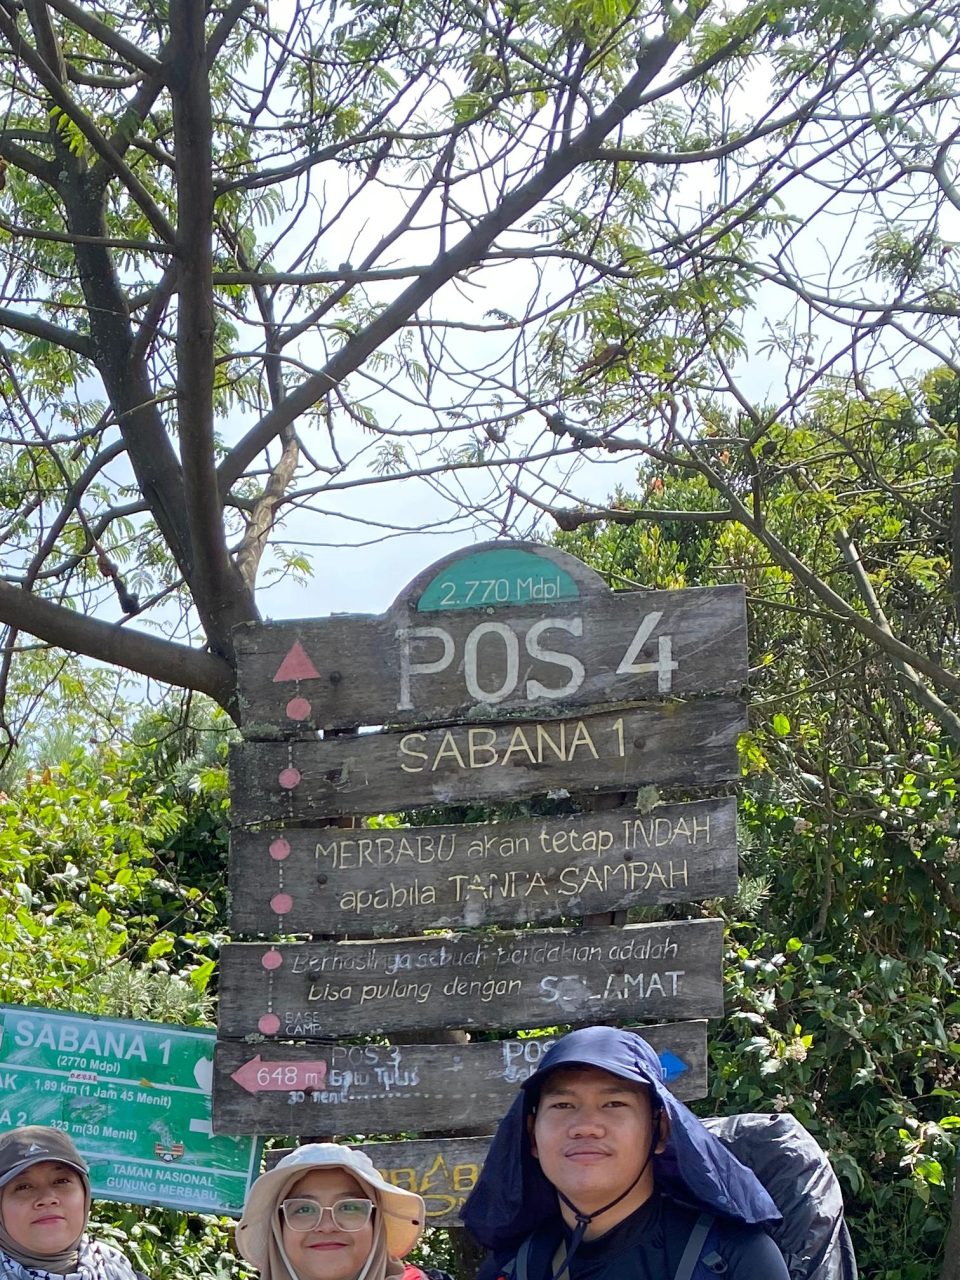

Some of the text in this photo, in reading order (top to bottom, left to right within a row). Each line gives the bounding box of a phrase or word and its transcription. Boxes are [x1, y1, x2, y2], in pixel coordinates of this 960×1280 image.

[440, 575, 561, 606] 2.770 Mdpl
[396, 611, 680, 711] POS 4
[399, 717, 626, 774] SABANA 1
[315, 815, 711, 869] MERBABU akan tetap INDAH
[558, 861, 689, 896] SAMPAH
[608, 937, 679, 961] adalah
[307, 982, 353, 1001] bisa
[360, 979, 431, 1004] pulang
[443, 975, 522, 1001] dengan
[285, 1011, 321, 1024] BASE
[285, 1023, 322, 1036] CAMP
[14, 1019, 173, 1066] SABANA 1
[56, 1054, 121, 1076] (2770 Mdpl)
[331, 1046, 379, 1067] POS
[256, 1066, 319, 1088] 648 m
[60, 1082, 77, 1095] km
[80, 1084, 91, 1097] (1
[93, 1086, 118, 1100] Jam
[120, 1089, 135, 1102] 45
[136, 1092, 172, 1109] Menit)
[16, 1110, 28, 1127] 2
[49, 1118, 70, 1132] 323
[102, 1125, 138, 1143] Menit)
[113, 1164, 216, 1188] TAMAN NASIONAL
[106, 1177, 218, 1201] GUNUNG MERBABU
